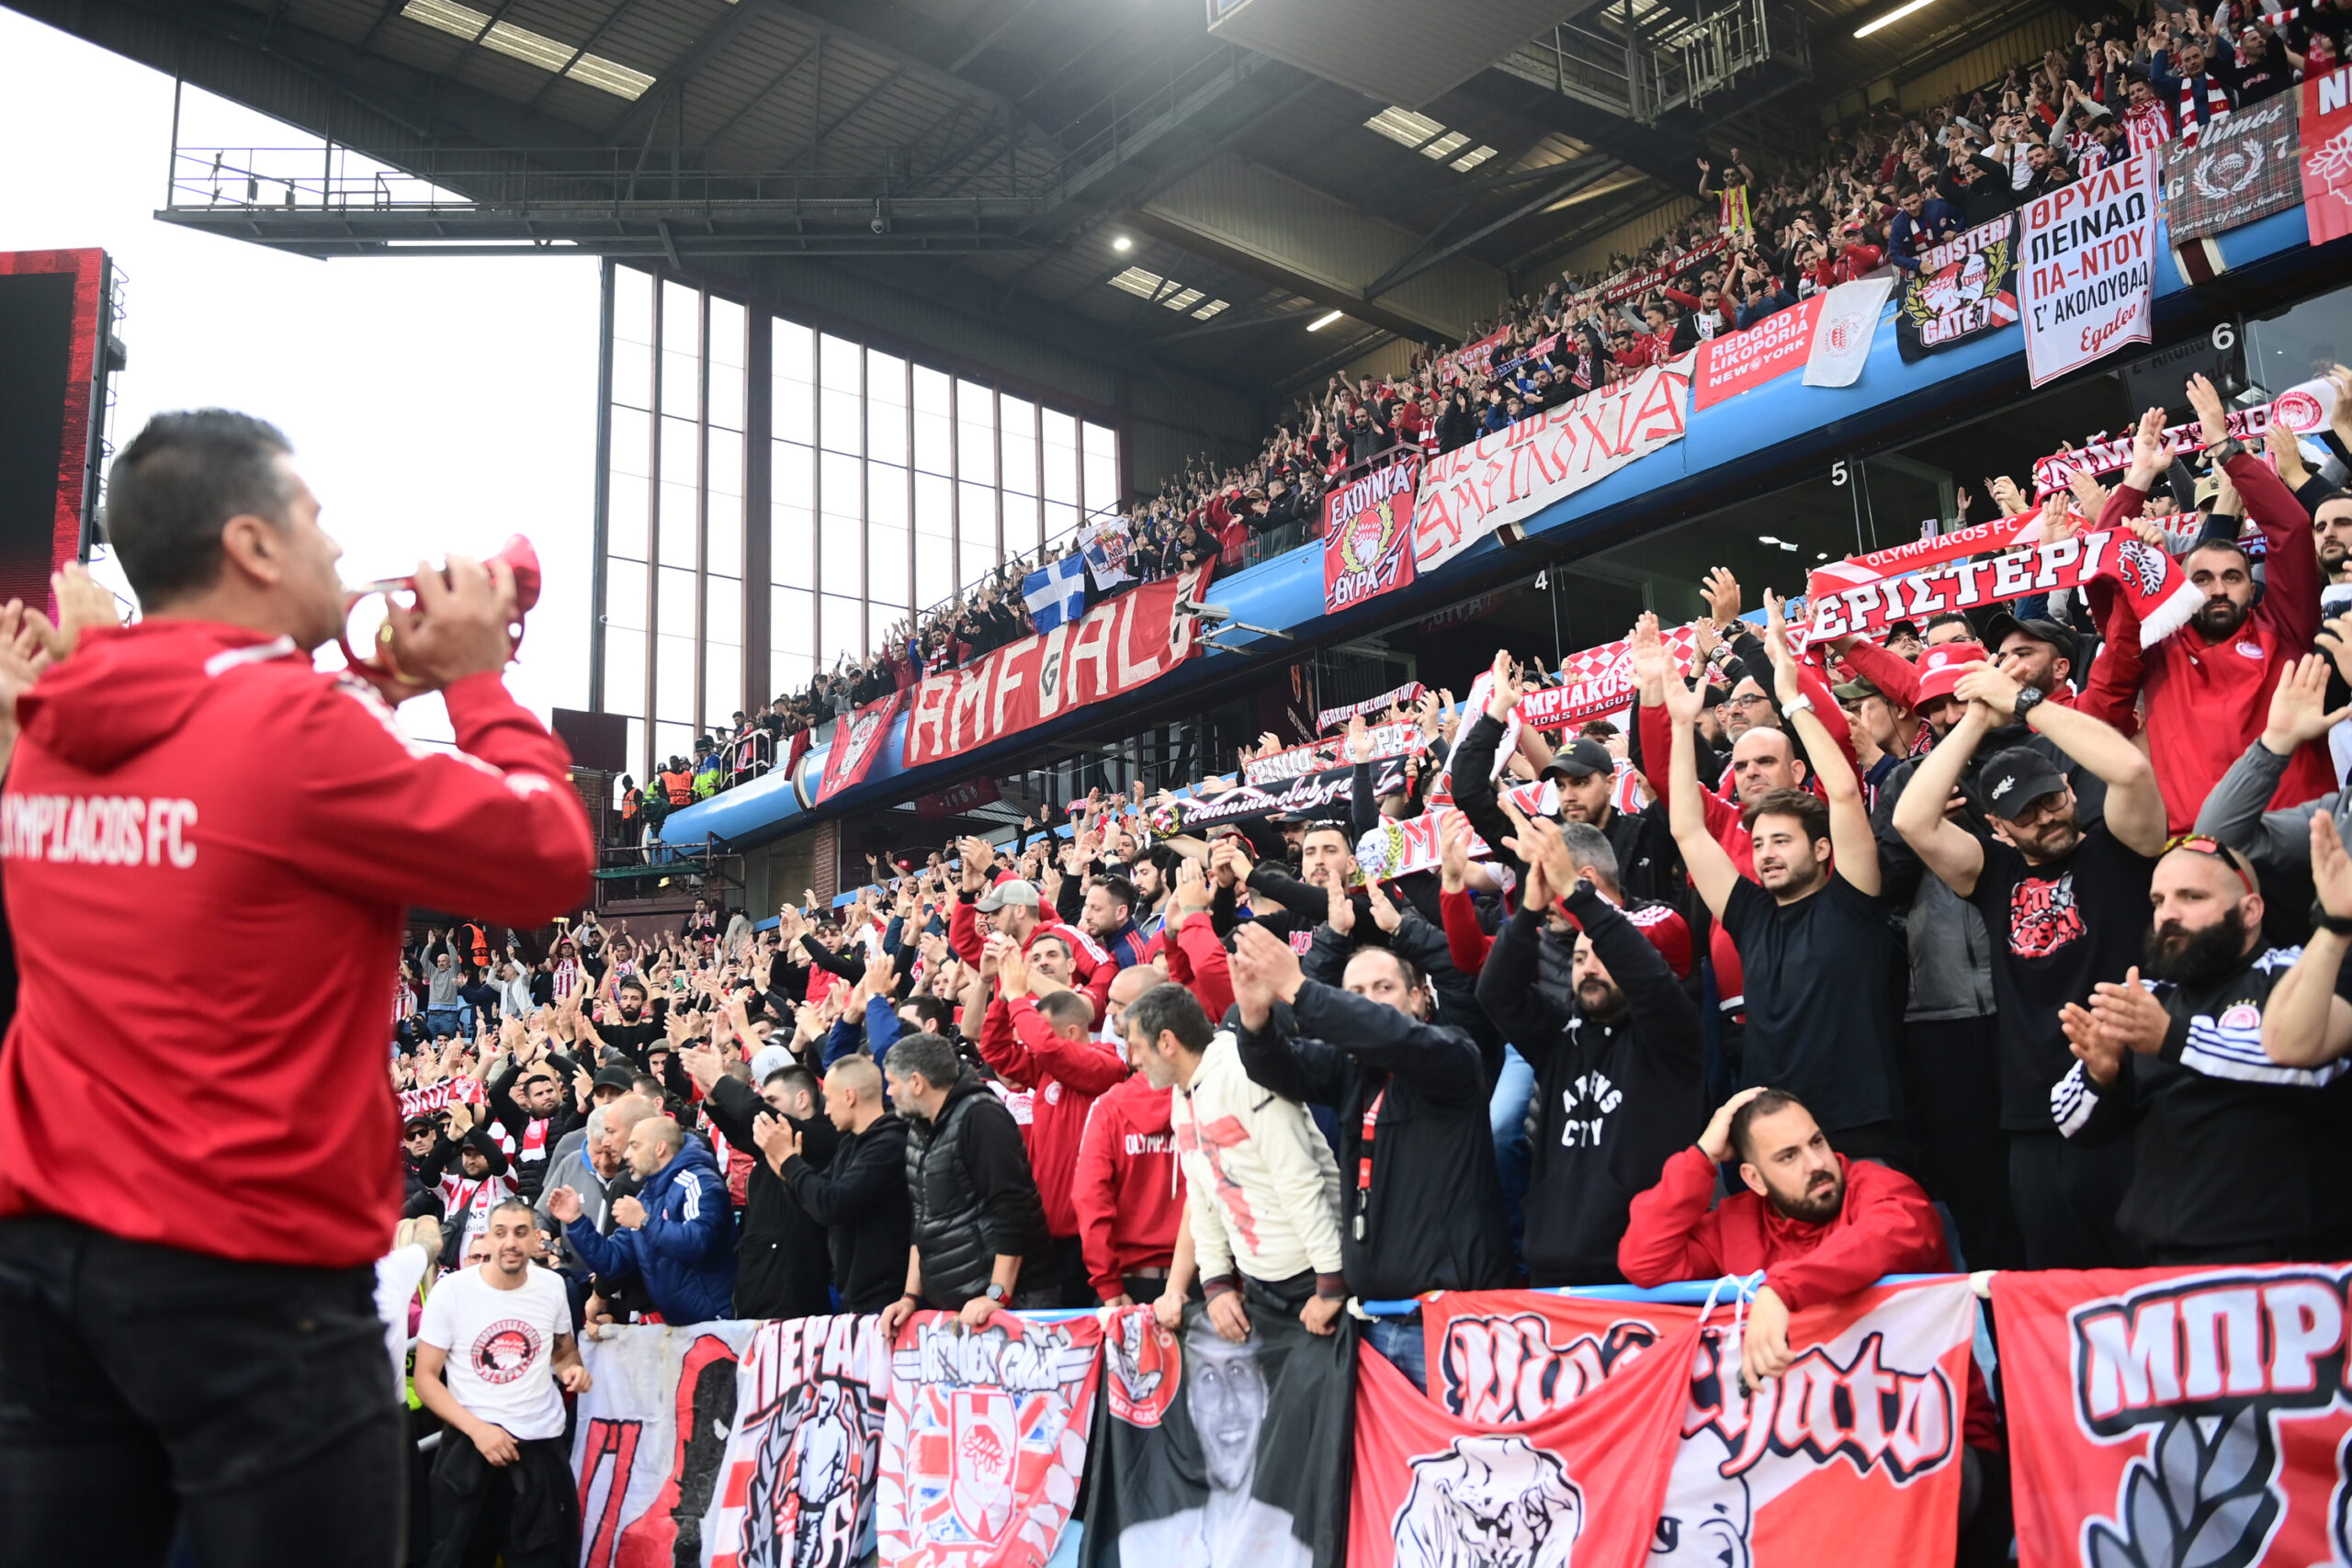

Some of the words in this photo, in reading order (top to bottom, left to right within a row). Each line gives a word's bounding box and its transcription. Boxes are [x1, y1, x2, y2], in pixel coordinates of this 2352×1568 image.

[2273, 135, 2290, 159] 7
[2031, 155, 2144, 230] ΘΡΥΛΕ
[2166, 176, 2185, 199] G
[1711, 237, 1722, 252] 7
[2031, 192, 2146, 265] ΠΕΙΝΑΩ
[2054, 261, 2148, 324] ΑΚΟΛΟΥΘΑΩ
[1712, 312, 1792, 360] REDGOD
[1798, 303, 1809, 318] 7
[1922, 310, 1978, 345] GATE
[1977, 298, 1992, 328] 7
[2212, 322, 2234, 350] 6
[1710, 319, 1808, 373] LIKOPORIA
[1710, 364, 1749, 388] NEW
[1763, 336, 1805, 364] YORK
[1831, 461, 1847, 486] 5
[1867, 526, 1989, 567] OLYMPIACOS
[1993, 517, 2018, 535] FC
[1335, 565, 1380, 605] ΘΥΡΑ
[1535, 570, 1548, 590] 4
[1577, 694, 1634, 717] LEAGUE
[1378, 761, 1397, 785] 7
[147, 795, 199, 870] FC
[2082, 1282, 2352, 1416] ΜΠΡ
